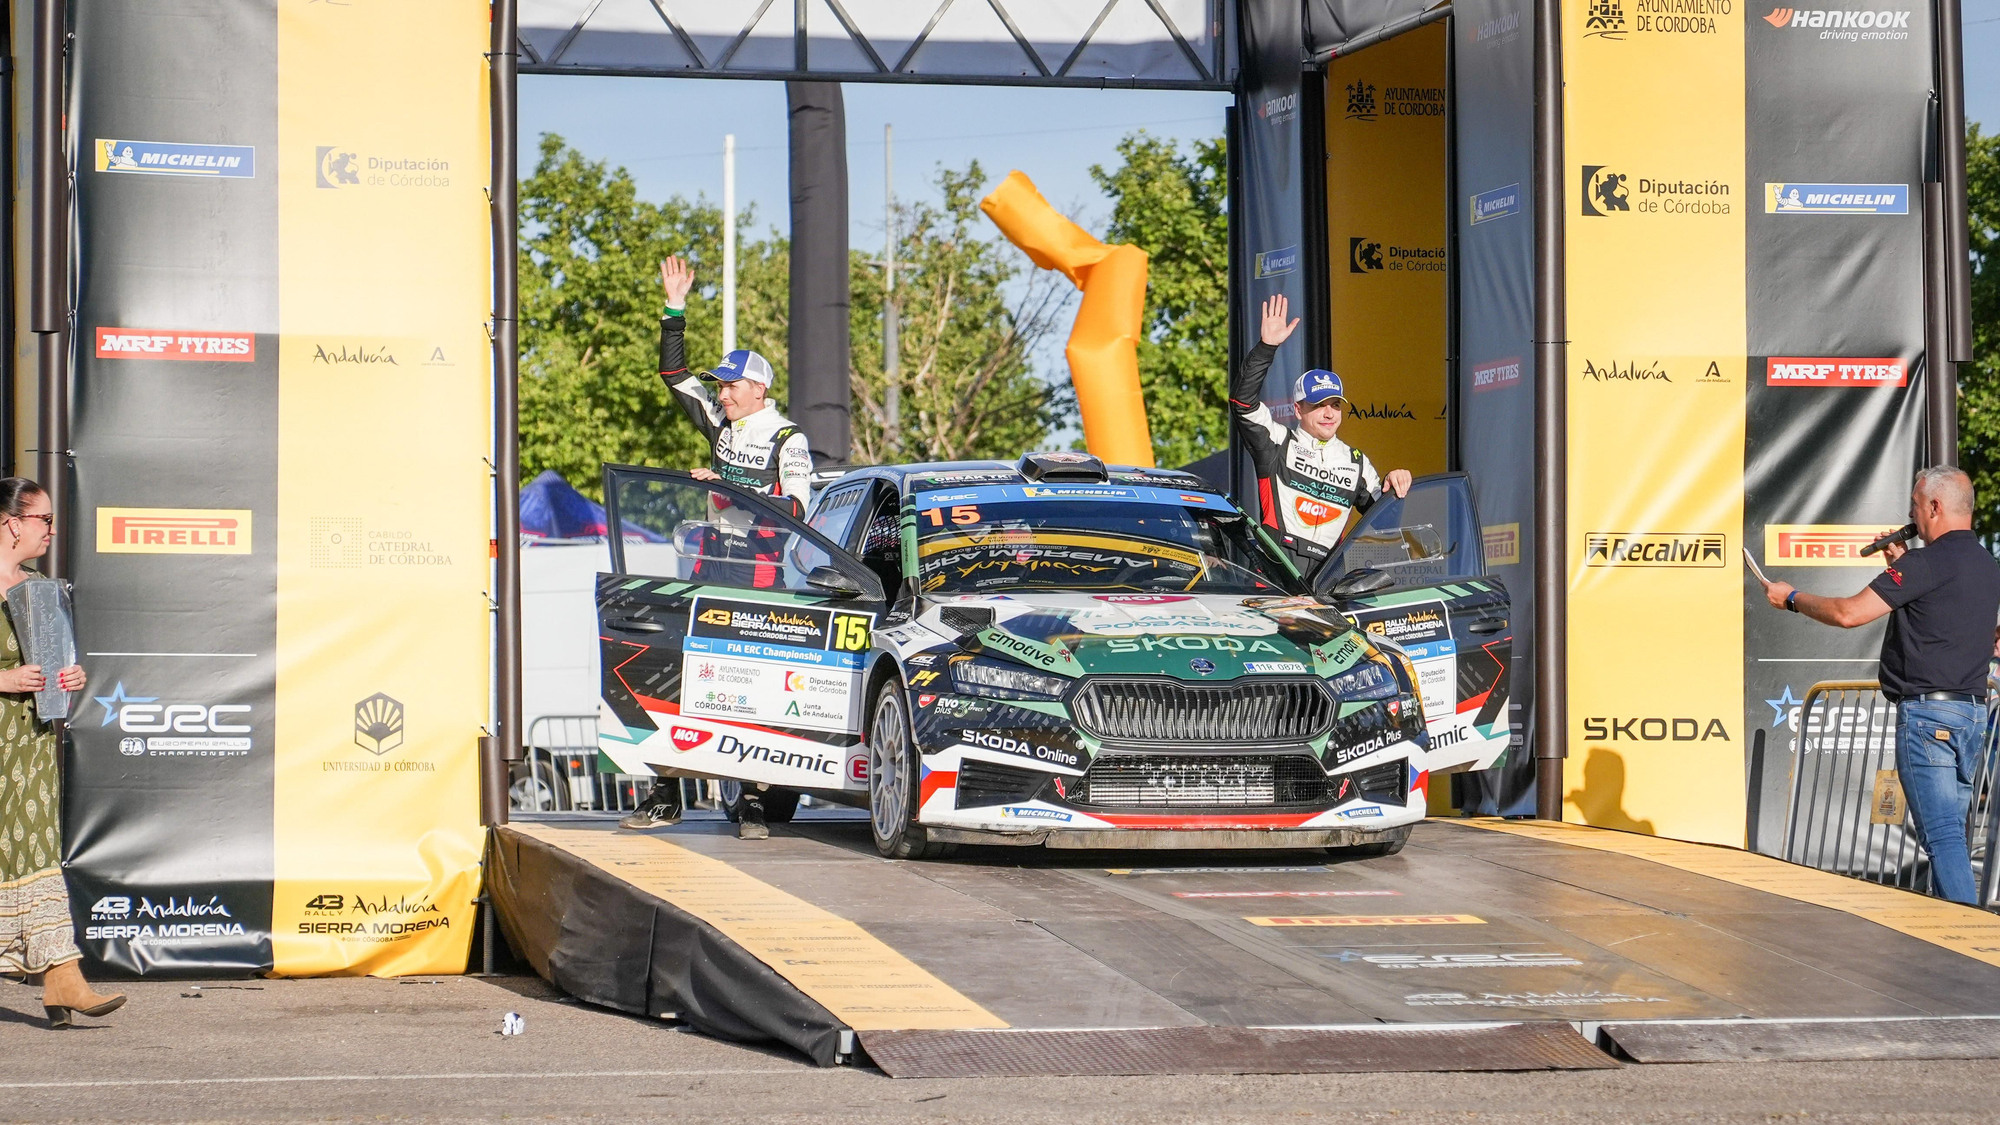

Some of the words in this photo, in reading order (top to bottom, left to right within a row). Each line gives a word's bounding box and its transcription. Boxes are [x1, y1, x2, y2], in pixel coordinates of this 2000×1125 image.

[1636, 0, 1731, 14] AYUNTAMIENTO
[1637, 15, 1652, 31] DE
[1820, 29, 1858, 42] driving
[1861, 30, 1908, 40] emotion
[1384, 102, 1396, 114] DE
[140, 152, 241, 168] MICHELIN
[368, 157, 449, 172] Diputación
[367, 174, 385, 187] de
[389, 172, 450, 187] Córdoba
[1639, 178, 1729, 197] Diputación
[1483, 195, 1515, 212] MICHELIN
[1638, 199, 1657, 213] de
[1663, 198, 1731, 215] Córdoba
[1805, 193, 1896, 206] MICHELIN
[1270, 254, 1295, 268] MICHELIN
[1389, 261, 1403, 271] de
[101, 335, 173, 352] MRF
[178, 337, 249, 354] TYRES
[312, 344, 399, 366] Andalucía
[1474, 368, 1496, 386] MRF
[1497, 363, 1519, 381] TYRES
[1582, 359, 1672, 383] Andalucía
[1771, 363, 1834, 380] MRF
[1838, 363, 1903, 381] TYRES
[1311, 384, 1339, 393] MICHELIN
[1347, 402, 1416, 420] Andalucía
[1294, 456, 1352, 487] Emotive
[1309, 481, 1337, 494] AUTO
[937, 493, 979, 501] ERC
[921, 505, 981, 526] 15
[1298, 501, 1328, 518] MOL
[112, 516, 238, 546] PIRELLI
[368, 531, 413, 540] CABILDO
[368, 541, 434, 553] CATEDRAL
[1610, 538, 1700, 563] Recalvi
[368, 554, 386, 565] DE
[389, 552, 453, 566] CÓRDOBA
[1393, 566, 1445, 575] CATEDRAL
[698, 609, 731, 626] 43
[732, 612, 768, 622] RALLY
[767, 611, 816, 628] Andalucía
[1385, 617, 1408, 627] RALLY
[731, 620, 772, 631] SIERRA
[772, 624, 821, 636] MORENA
[834, 616, 868, 650] 15
[1386, 624, 1412, 636] SIERRA
[1412, 619, 1444, 632] MORENA
[727, 643, 742, 653] FIA
[744, 645, 761, 655] ERC
[763, 647, 822, 663] Championship
[719, 665, 760, 677] AYUNTAMIENTO
[1256, 663, 1274, 671] 11R
[1277, 663, 1302, 671] 0878
[1421, 668, 1445, 678] Diputación
[718, 674, 725, 682] DE
[809, 677, 847, 688] Diputación
[818, 686, 847, 695] Córdoba
[695, 701, 732, 712] CÓRDOBA
[937, 698, 958, 707] EVO
[120, 704, 251, 733] ERC
[811, 710, 843, 720] Andalucía
[934, 707, 952, 715] plus
[673, 729, 699, 743] MOL
[1386, 730, 1402, 745] Plus
[121, 740, 144, 754] FIA
[716, 734, 838, 775] Dynamic
[1036, 745, 1077, 766] Online
[323, 761, 380, 771] UNIVERSIDAD
[394, 759, 435, 772] CÓRDOBA
[853, 759, 868, 778] E
[1017, 808, 1069, 819] MICHELIN
[1348, 807, 1380, 817] MICHELIN
[91, 896, 130, 914] 43
[136, 896, 231, 919] Andalucía
[305, 894, 344, 909] 43
[351, 895, 440, 915] Andalucía
[85, 925, 154, 939] SIERRA
[159, 923, 244, 937] MORENA
[298, 922, 367, 934] SIERRA
[373, 917, 450, 934] MORENA
